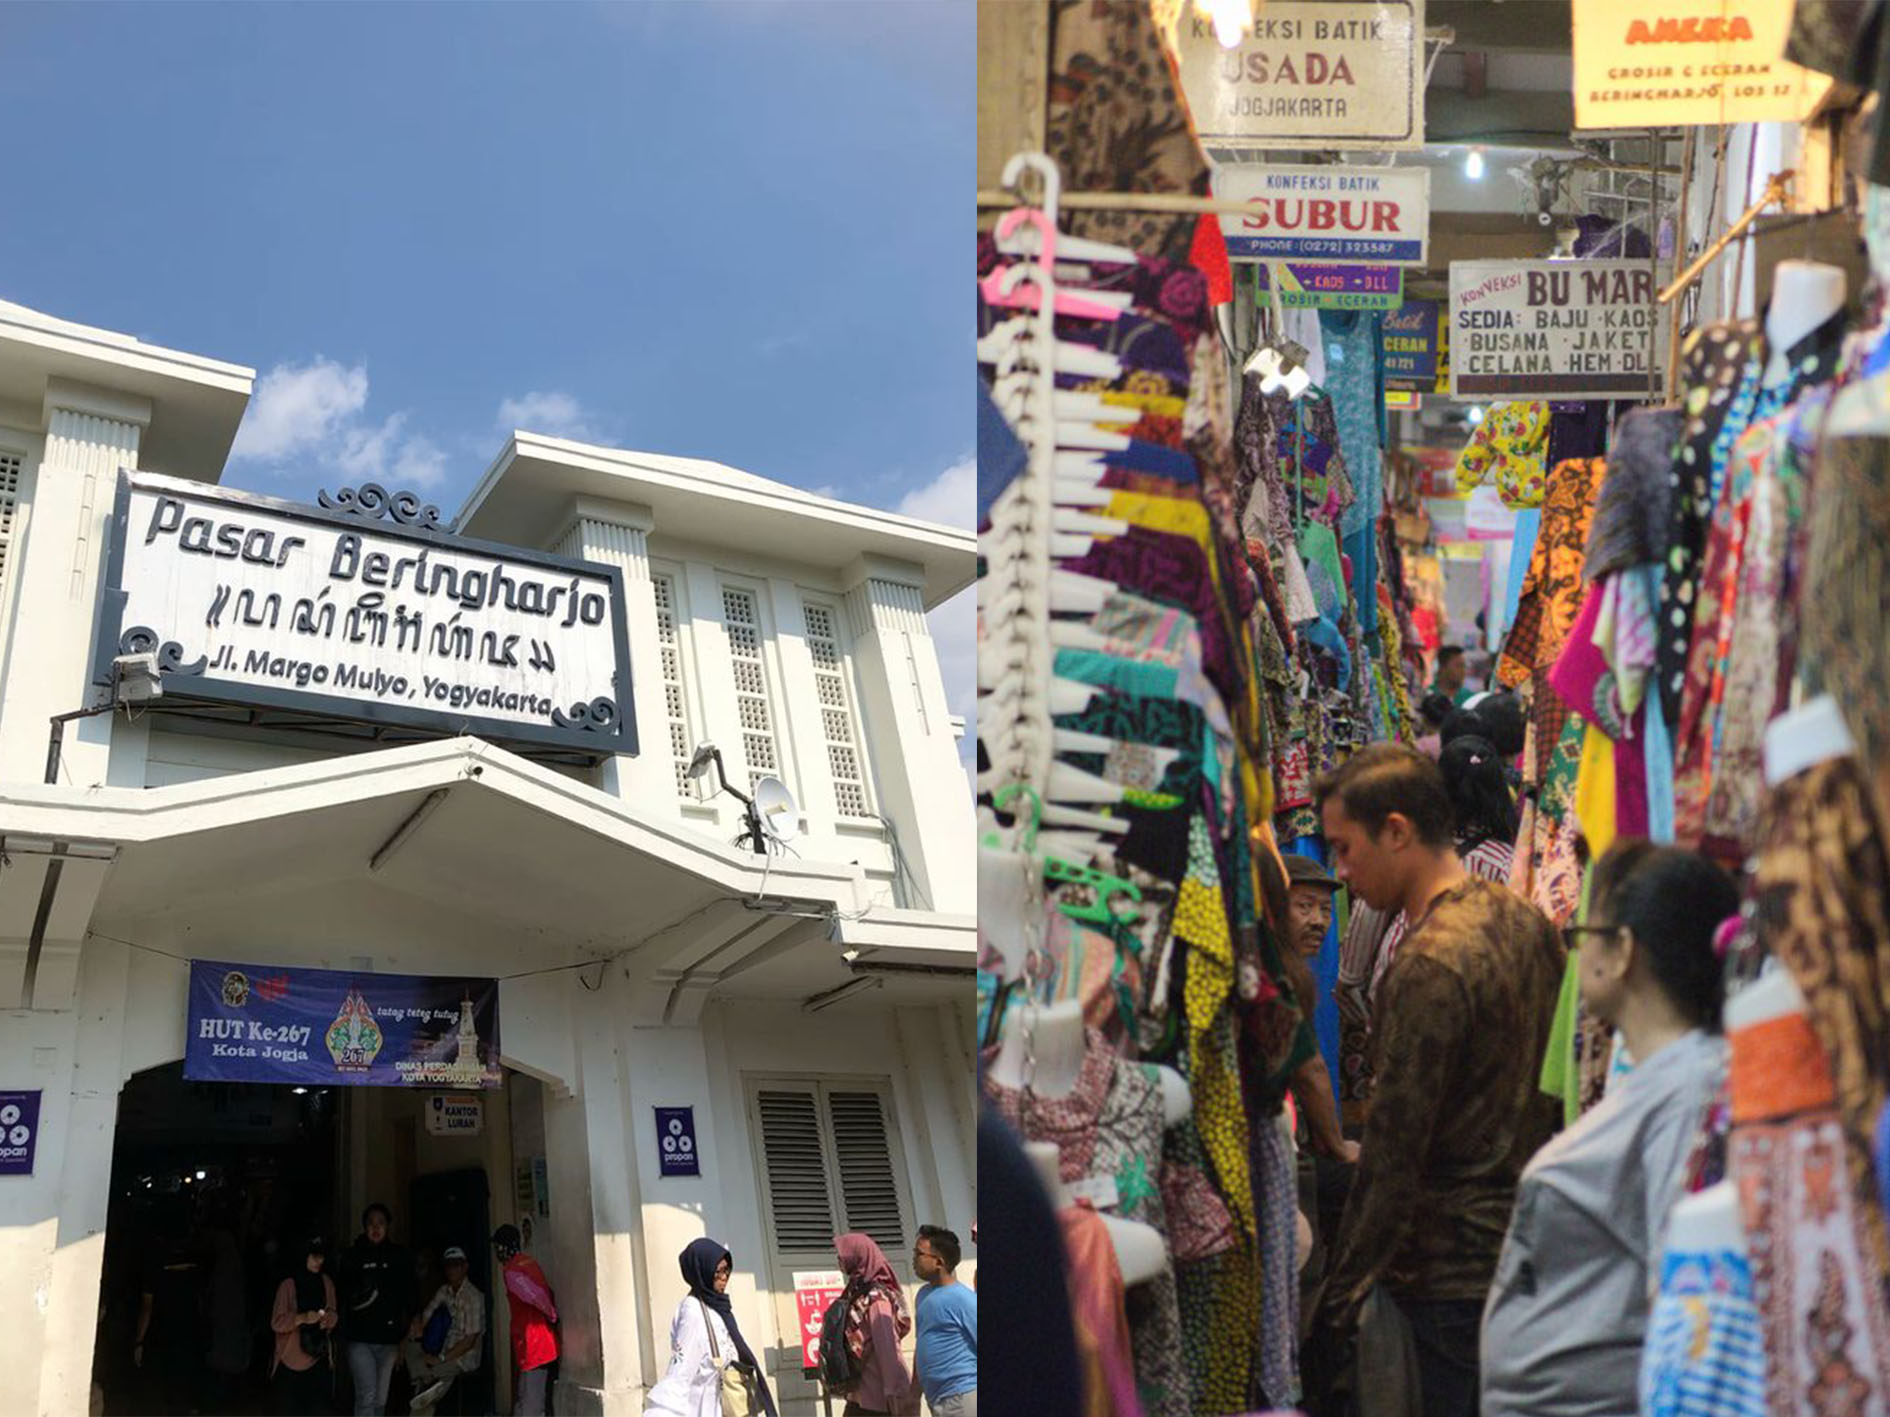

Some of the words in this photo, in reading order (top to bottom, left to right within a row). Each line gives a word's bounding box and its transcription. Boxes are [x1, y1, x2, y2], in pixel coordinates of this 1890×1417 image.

[1192, 18, 1302, 40] KEKSI
[1315, 19, 1383, 41] BATIK
[1229, 98, 1347, 118] JOGJAKARTA
[1267, 175, 1331, 191] KONFEKSI
[1339, 176, 1380, 191] BATIK
[1242, 197, 1401, 232] SUBUR
[1460, 273, 1522, 306] KONVEKSI
[1527, 270, 1570, 306] BU
[1581, 268, 1654, 306] MAR
[1280, 292, 1321, 305] ROSIR
[1536, 309, 1589, 329] BAJU
[1470, 332, 1550, 352] BUSANA
[1572, 331, 1649, 351] JAKET
[1468, 354, 1553, 374] CELANA
[1569, 353, 1611, 372] HEM
[145, 496, 306, 568] Pasar
[328, 531, 606, 627] Beringharjo
[209, 644, 237, 671] Jl.
[244, 649, 329, 687] Margo
[333, 663, 417, 701] Mulyo,
[423, 676, 552, 717] Yogyakarta
[199, 1018, 244, 1039] HUT
[212, 1043, 257, 1058] Kota
[262, 1046, 309, 1062] Jogja
[342, 1049, 364, 1063] 267
